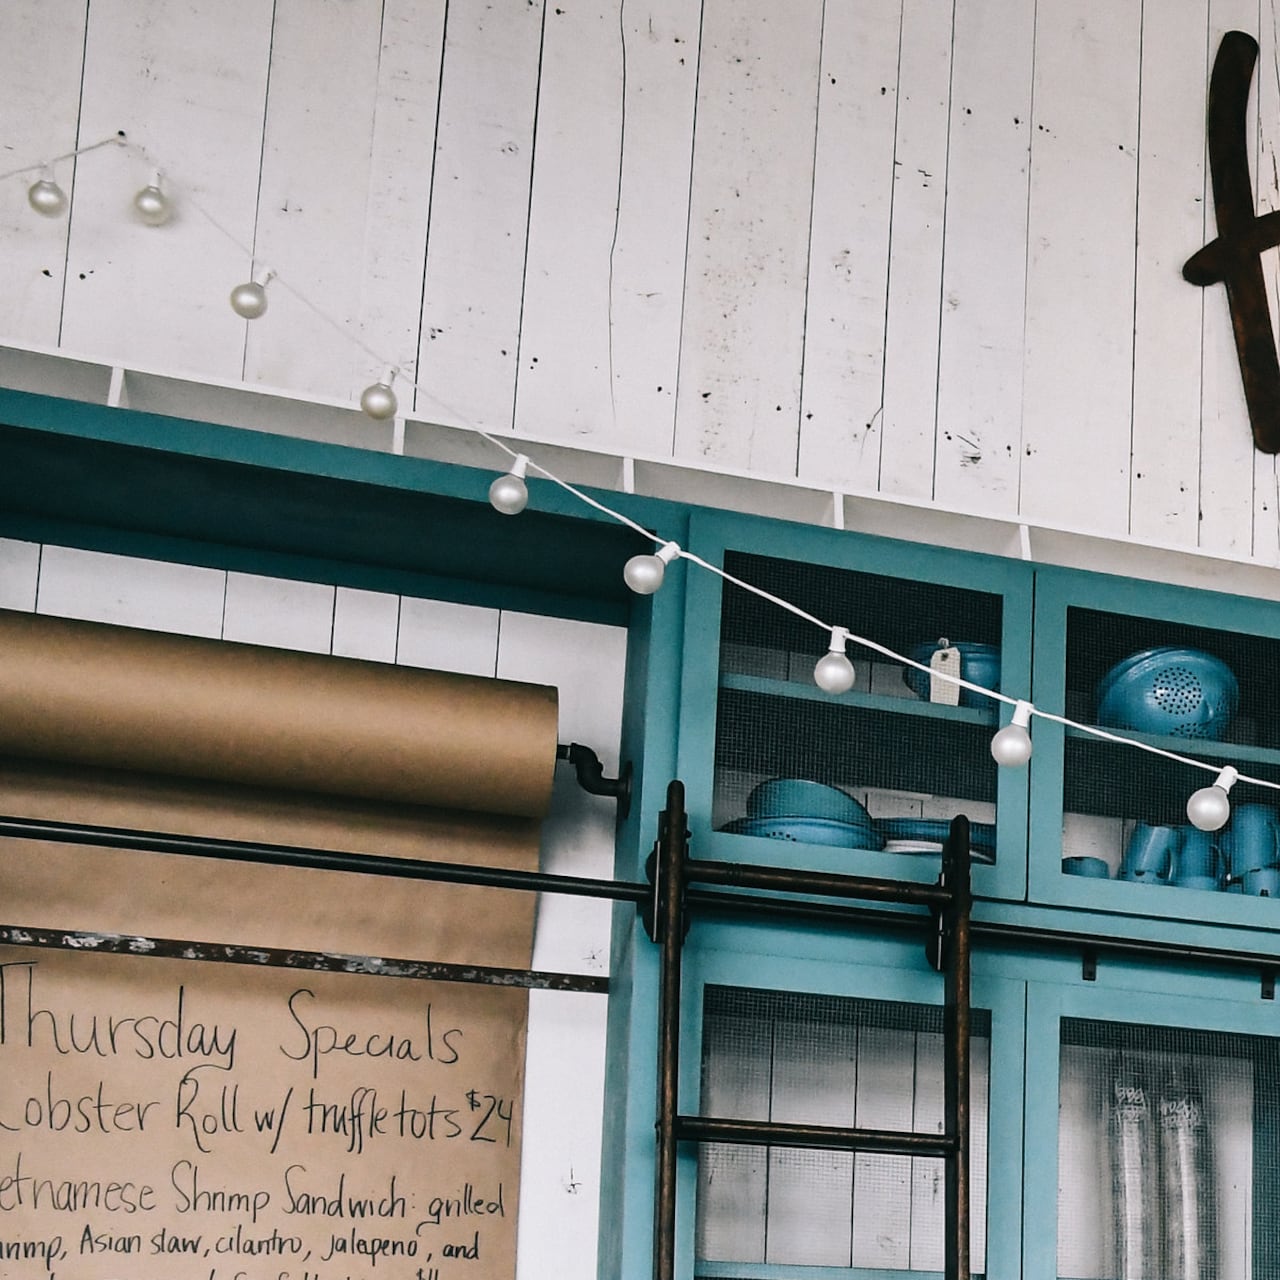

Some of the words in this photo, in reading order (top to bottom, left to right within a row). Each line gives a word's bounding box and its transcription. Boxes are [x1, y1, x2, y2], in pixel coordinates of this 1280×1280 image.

[0, 961, 237, 1083] Thursday
[280, 989, 463, 1078] Specials
[0, 1071, 160, 1133] obster
[175, 1078, 244, 1153] Roll
[255, 1087, 293, 1153] w/
[465, 1089, 514, 1148] $24
[172, 1160, 271, 1223] Shrimp
[415, 1180, 505, 1236] grilled
[80, 1224, 141, 1255] Asian
[150, 1228, 210, 1259] slaw,
[216, 1228, 311, 1261] cilantro,
[442, 1231, 480, 1261] and
